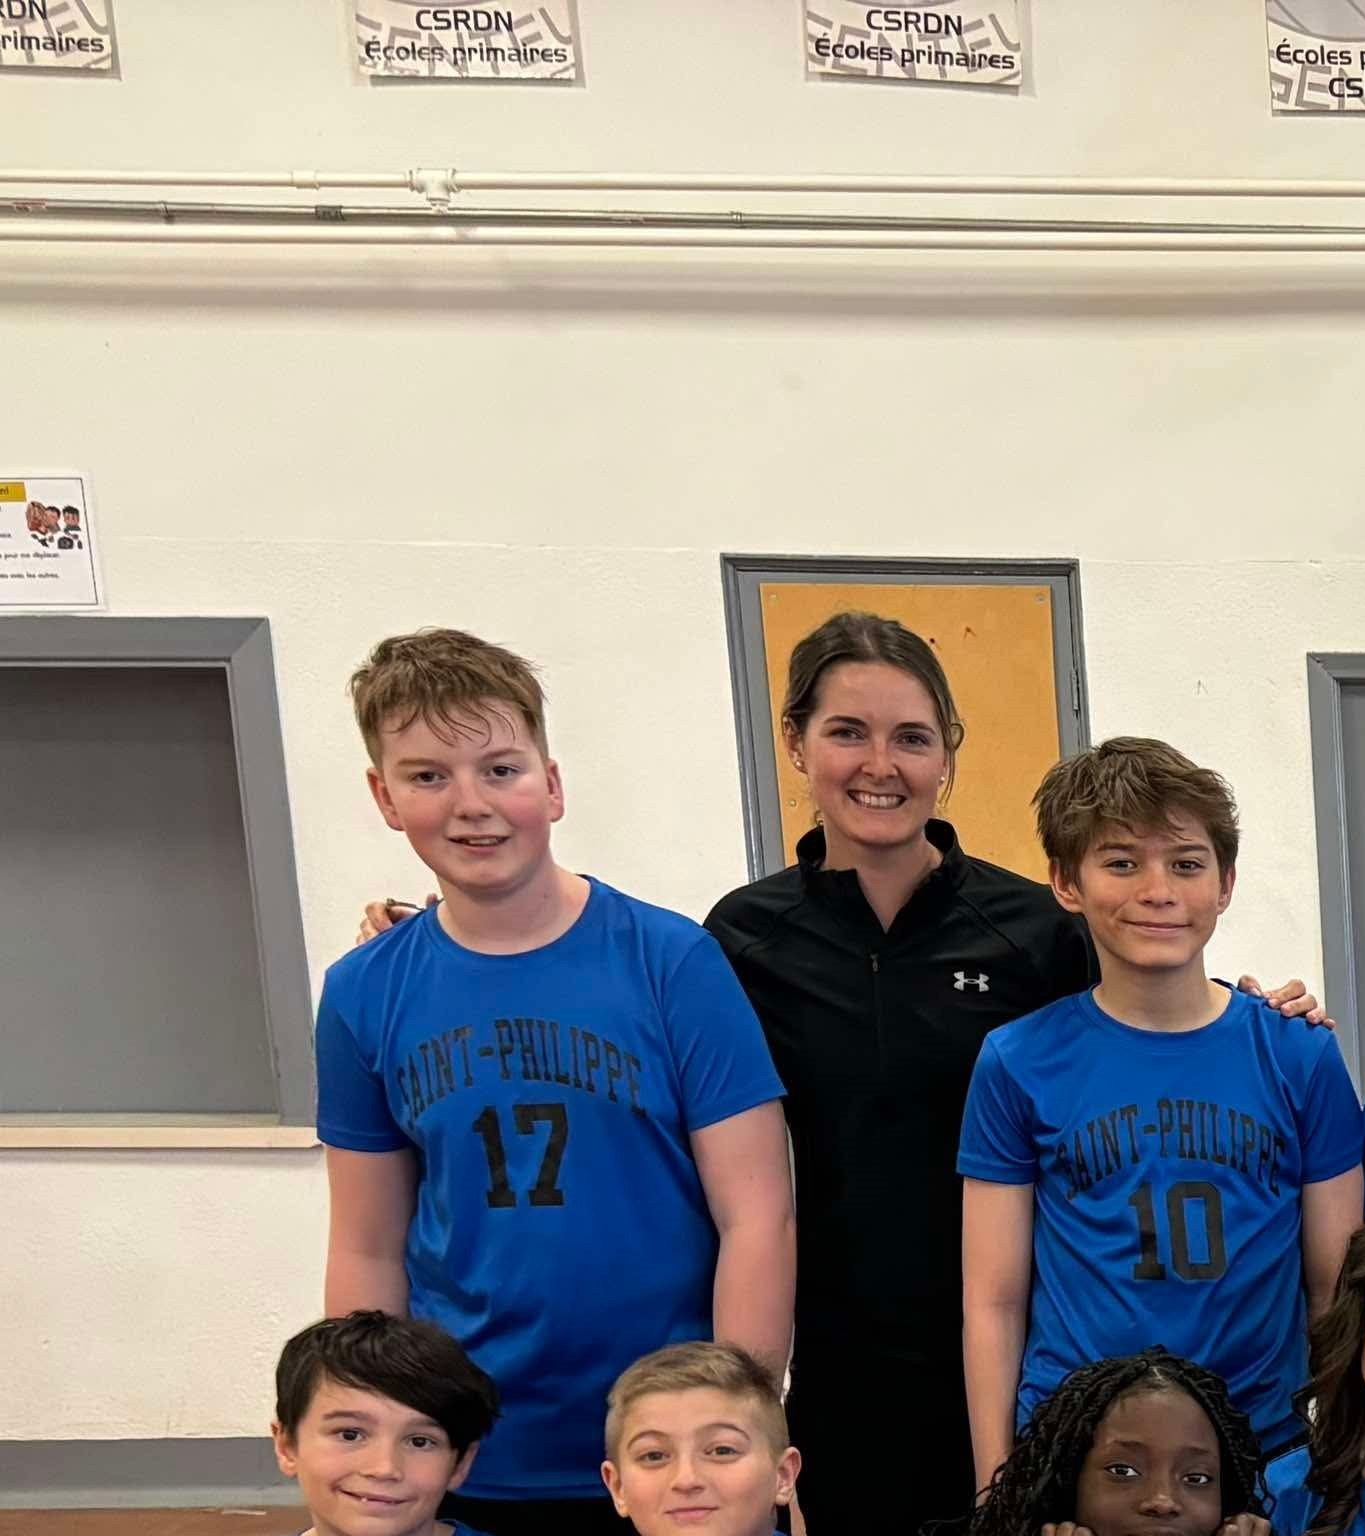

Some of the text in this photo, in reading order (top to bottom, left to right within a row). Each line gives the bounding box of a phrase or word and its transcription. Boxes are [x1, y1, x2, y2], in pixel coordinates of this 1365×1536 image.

[415, 9, 513, 32] CSRDN
[866, 9, 963, 36] CSRDN
[1, 30, 104, 52] rimaires
[365, 35, 567, 65] Écoles primaires
[814, 32, 1015, 70] Écoles primaires
[1275, 38, 1352, 65] Écoles
[395, 1018, 647, 1131] SAINT-PHILIPPE
[472, 1102, 569, 1208] 17
[1128, 1181, 1228, 1284] 10
